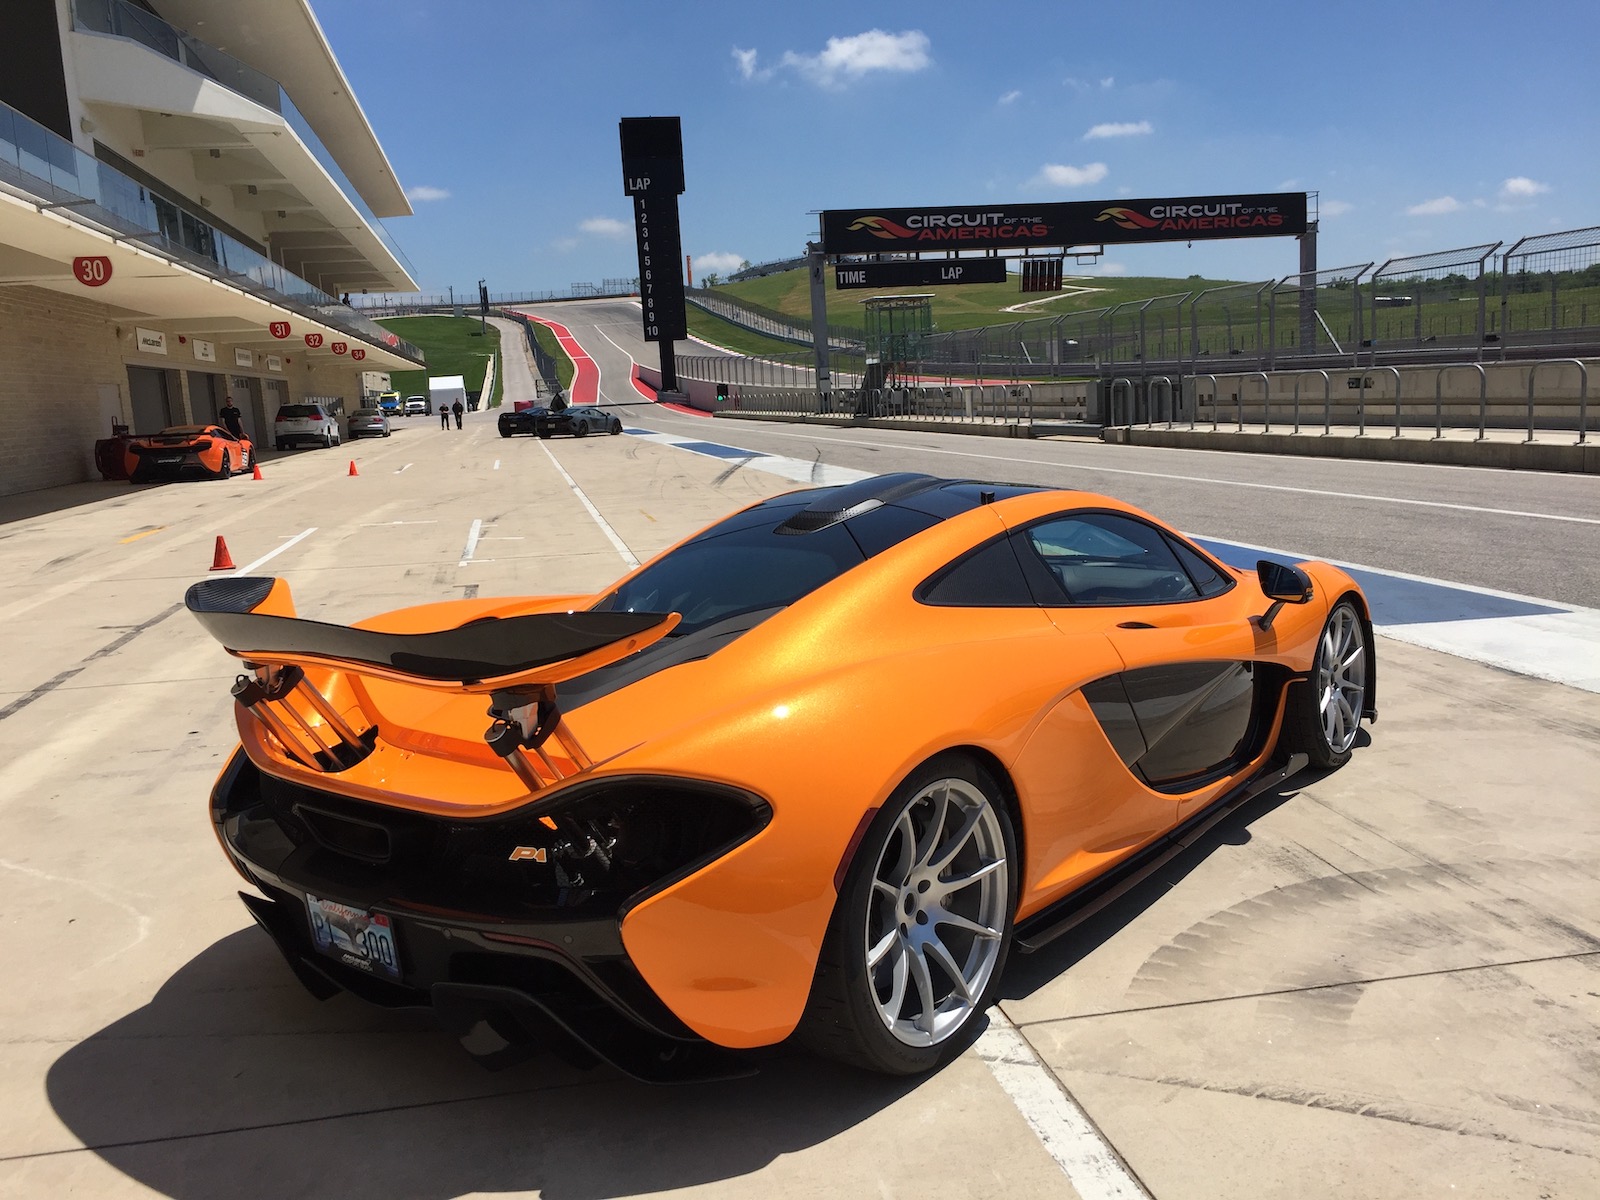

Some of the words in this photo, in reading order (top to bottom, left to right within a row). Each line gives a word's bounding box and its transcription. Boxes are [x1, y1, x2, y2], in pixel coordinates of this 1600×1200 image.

[629, 178, 650, 190] LAP
[640, 199, 645, 209] 1
[1149, 203, 1242, 218] CIRCUIT
[1256, 206, 1278, 214] THE
[641, 213, 647, 223] 2
[906, 213, 1004, 227] CIRCUIT
[1003, 217, 1019, 225] OF
[1020, 216, 1043, 224] THE
[1160, 215, 1283, 230] AMERICAS
[642, 227, 648, 238] 3
[918, 225, 1048, 240] AMERICAS
[643, 241, 650, 252] 4
[645, 256, 651, 266] 5
[82, 260, 104, 281] 30
[646, 270, 652, 280] 6
[941, 267, 963, 280] LAP
[838, 270, 866, 284] TIME
[647, 284, 653, 294] 7
[648, 298, 654, 308] 8
[649, 312, 655, 322] 9
[275, 324, 286, 336] 31
[647, 326, 658, 336] 10
[308, 335, 320, 346] 32
[335, 344, 345, 353] 33
[354, 351, 363, 359] 34
[508, 846, 547, 863] P1
